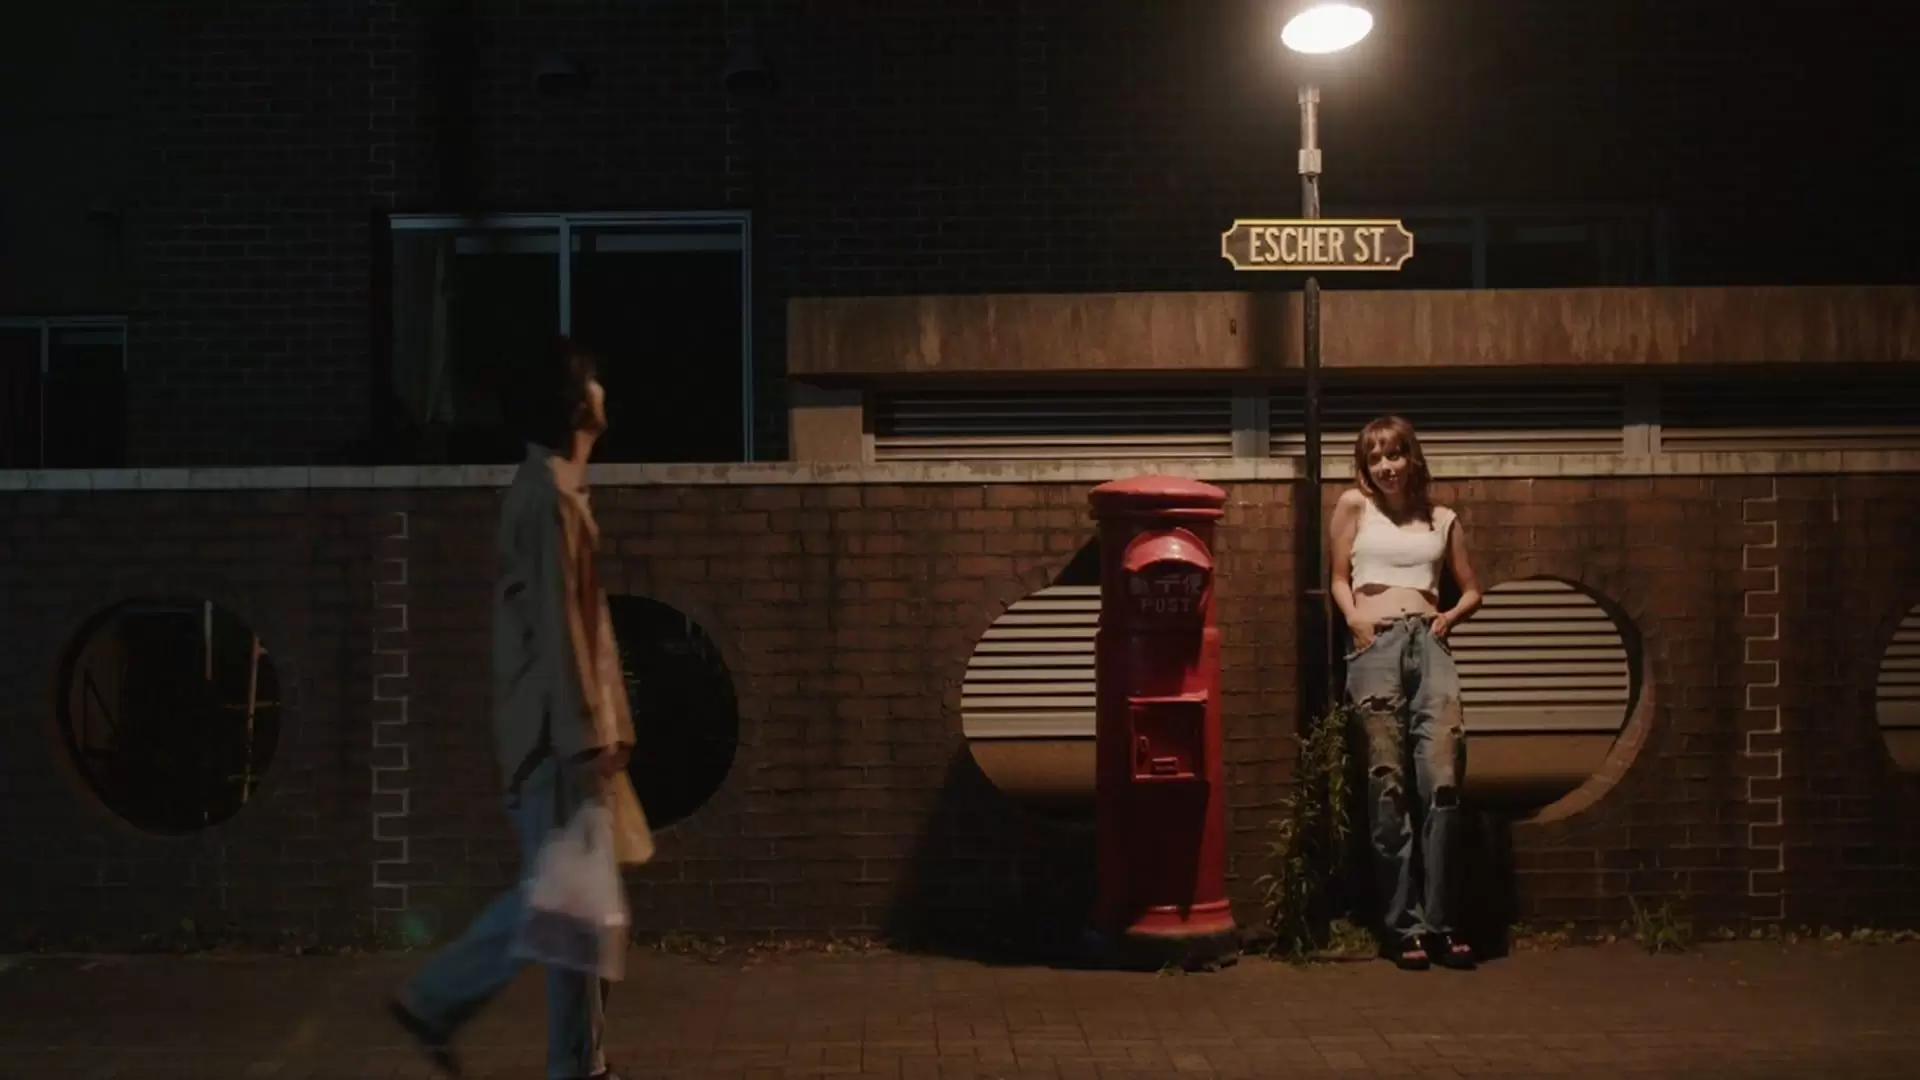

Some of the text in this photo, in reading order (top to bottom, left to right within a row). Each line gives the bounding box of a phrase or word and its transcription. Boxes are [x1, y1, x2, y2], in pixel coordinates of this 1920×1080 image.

[1249, 227, 1392, 263] ESCHER ST.
[1140, 597, 1191, 613] POST
